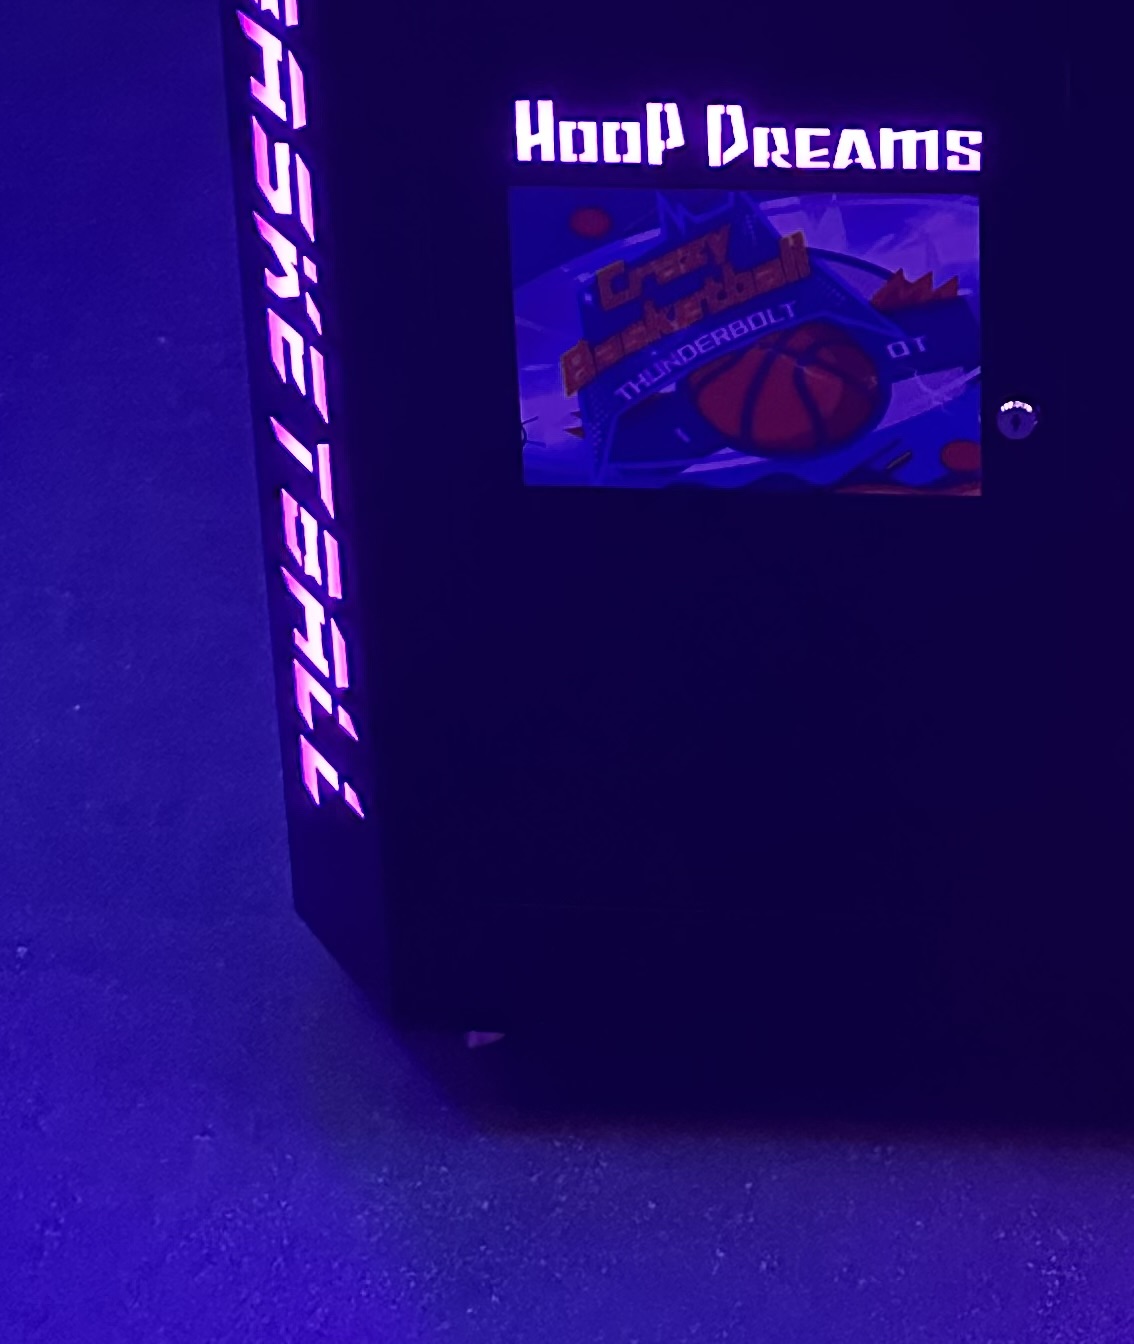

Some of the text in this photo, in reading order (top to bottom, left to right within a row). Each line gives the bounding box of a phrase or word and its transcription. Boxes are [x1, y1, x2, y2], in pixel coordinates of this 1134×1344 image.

[560, 229, 811, 399] Basketball
[595, 223, 731, 311] Crazy
[613, 299, 798, 401] THUNDERBOLT
